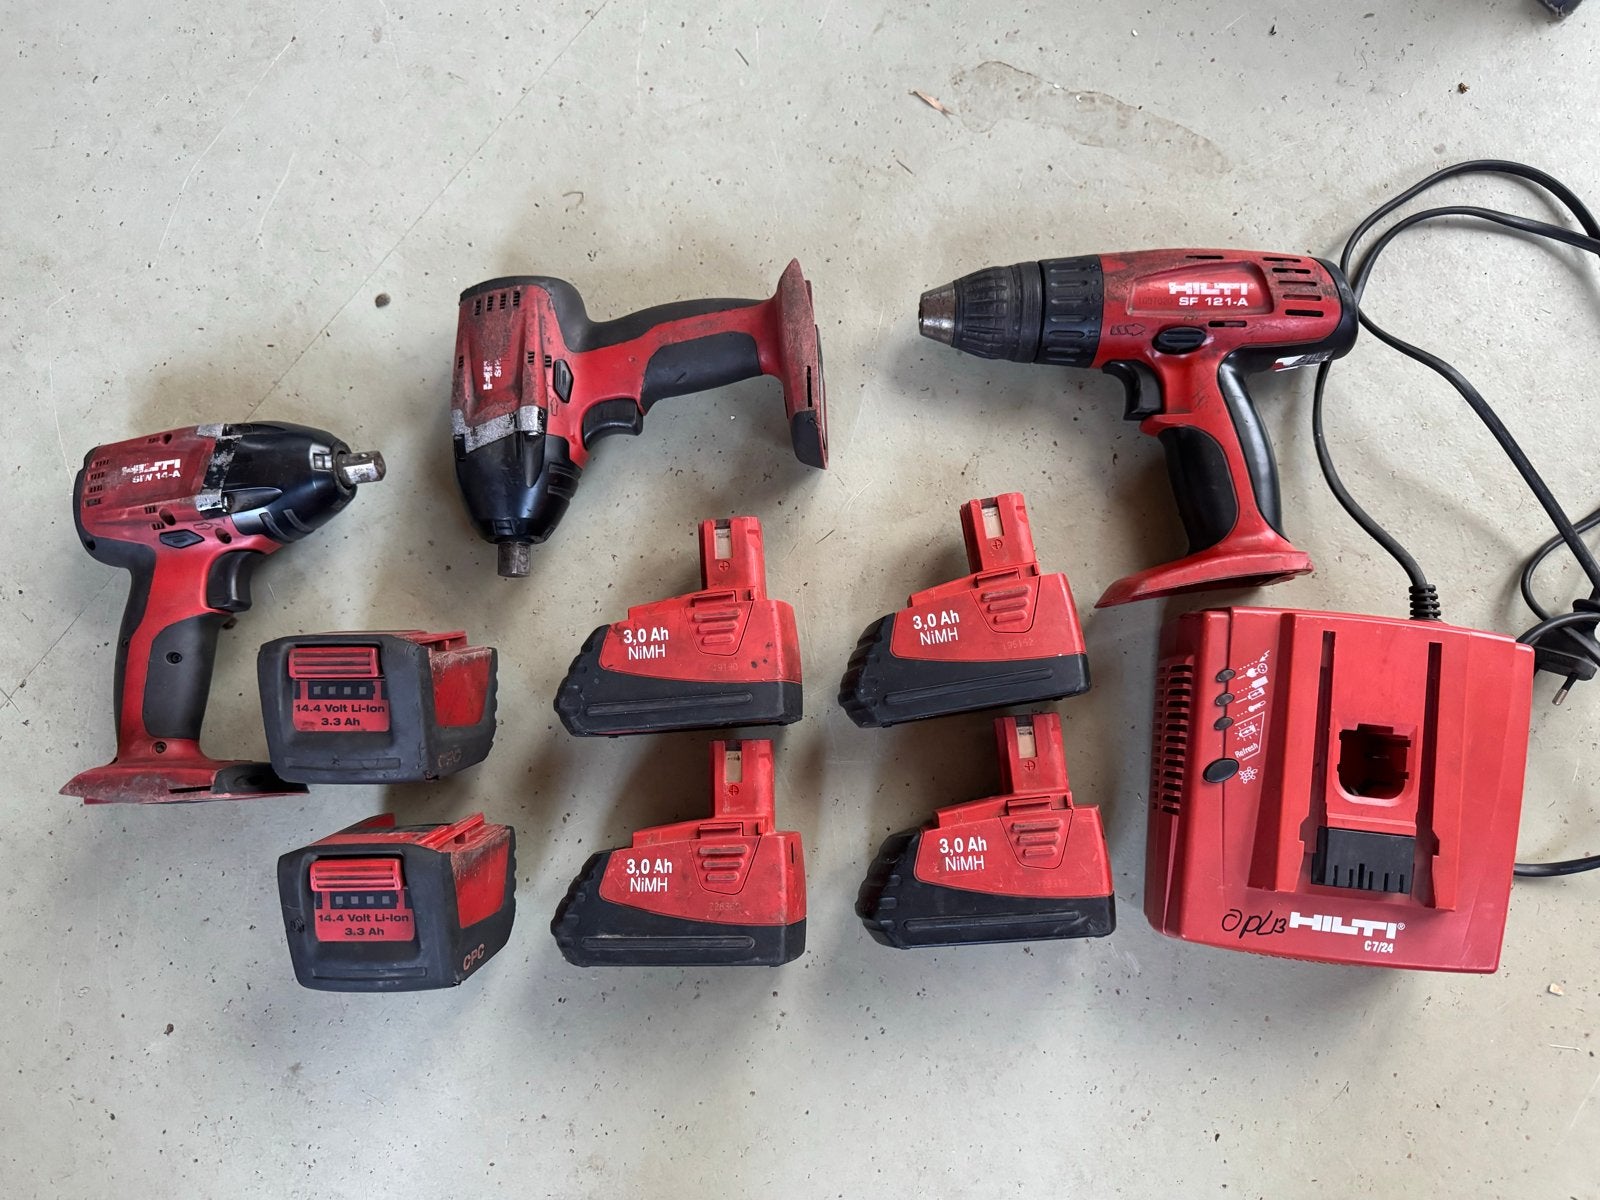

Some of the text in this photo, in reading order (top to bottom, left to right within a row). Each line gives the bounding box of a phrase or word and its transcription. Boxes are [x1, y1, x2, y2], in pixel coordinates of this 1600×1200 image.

[1168, 282, 1248, 295] HILTI
[1178, 297, 1199, 306] SF
[1204, 297, 1249, 307] 121-A
[913, 609, 960, 631] 3,0 Ah
[623, 627, 669, 645] 3,0 Ah
[920, 627, 958, 645] NiMH
[628, 644, 666, 660] NiMH
[295, 703, 385, 713] 14.4 Volt Li-Ion
[321, 716, 361, 727] 3.3 Ah
[1234, 742, 1259, 759] Refresh
[939, 836, 988, 856] 3,0 Ah
[626, 858, 673, 876] 3,0 Ah
[945, 855, 985, 872] NiMH
[629, 877, 668, 892] NiMH
[318, 914, 409, 923] 14.4 Volt Li-Ion
[344, 927, 385, 937] 3.3 Ah
[463, 944, 485, 971] CPC
